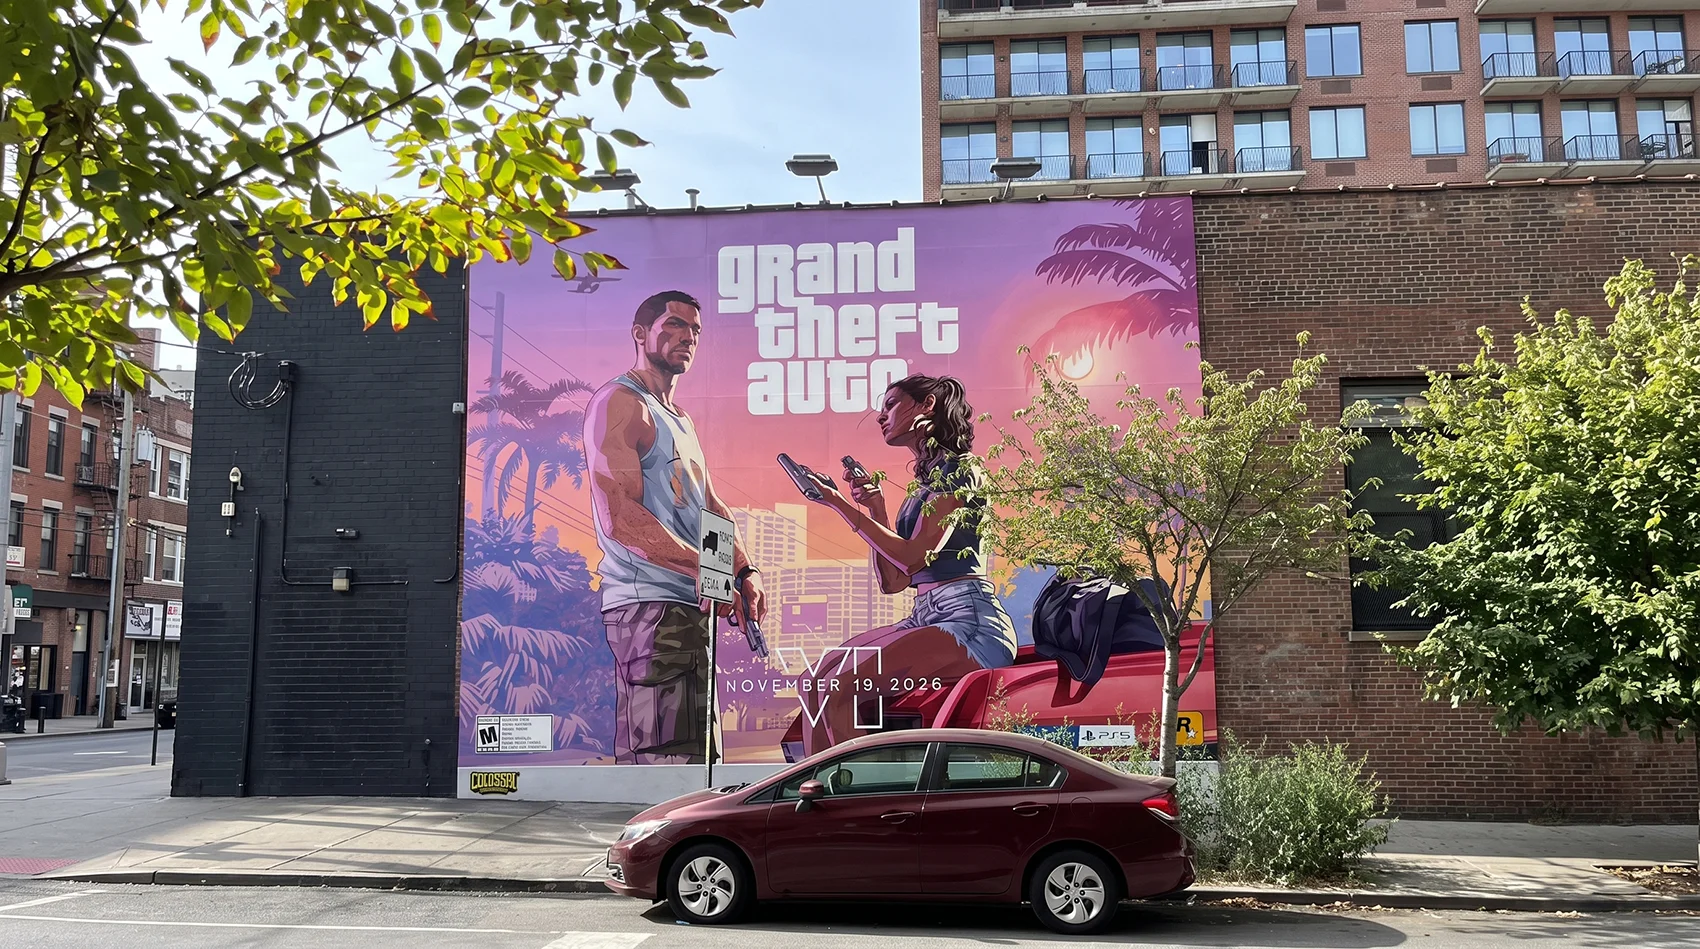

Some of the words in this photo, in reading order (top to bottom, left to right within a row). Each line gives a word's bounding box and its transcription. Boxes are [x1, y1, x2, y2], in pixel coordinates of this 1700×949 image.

[754, 296, 960, 359] theft
[726, 679, 841, 693] NOVEMBER
[853, 678, 881, 693] 19,
[890, 677, 942, 692] 2026
[1176, 716, 1191, 733] R
[479, 726, 497, 745] M
[1098, 731, 1131, 740] PS5
[471, 772, 517, 791] COLOSSAL
